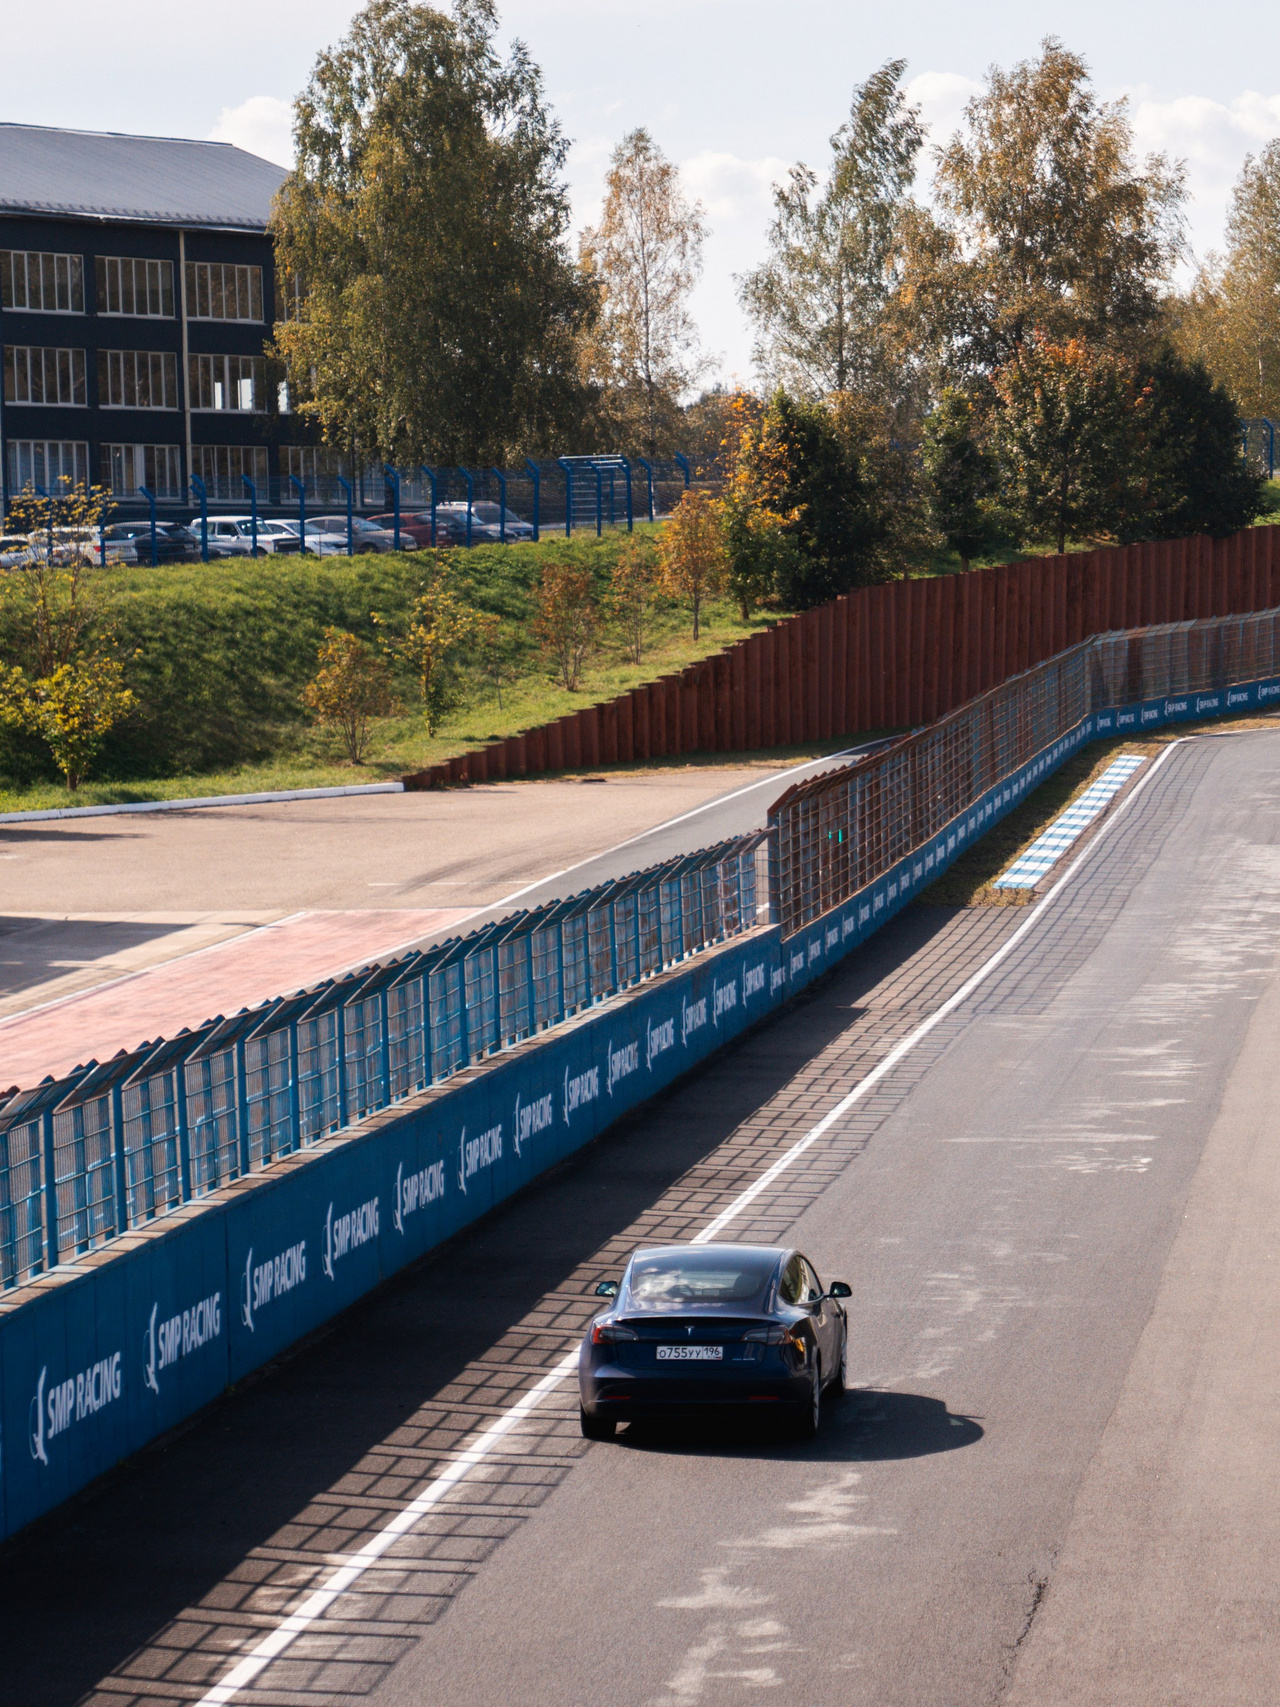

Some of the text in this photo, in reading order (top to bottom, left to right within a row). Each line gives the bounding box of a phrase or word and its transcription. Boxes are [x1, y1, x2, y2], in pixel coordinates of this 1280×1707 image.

[466, 1124, 502, 1178] SMP RACING
[520, 1104, 532, 1142] SMP
[403, 1160, 444, 1217] SMP RACING
[333, 1197, 379, 1260] SMP RACING
[253, 1240, 306, 1310] SMP RACING
[158, 1291, 221, 1370] SMP RACING
[703, 1346, 720, 1356] 196
[47, 1351, 121, 1440] SMP RACING
